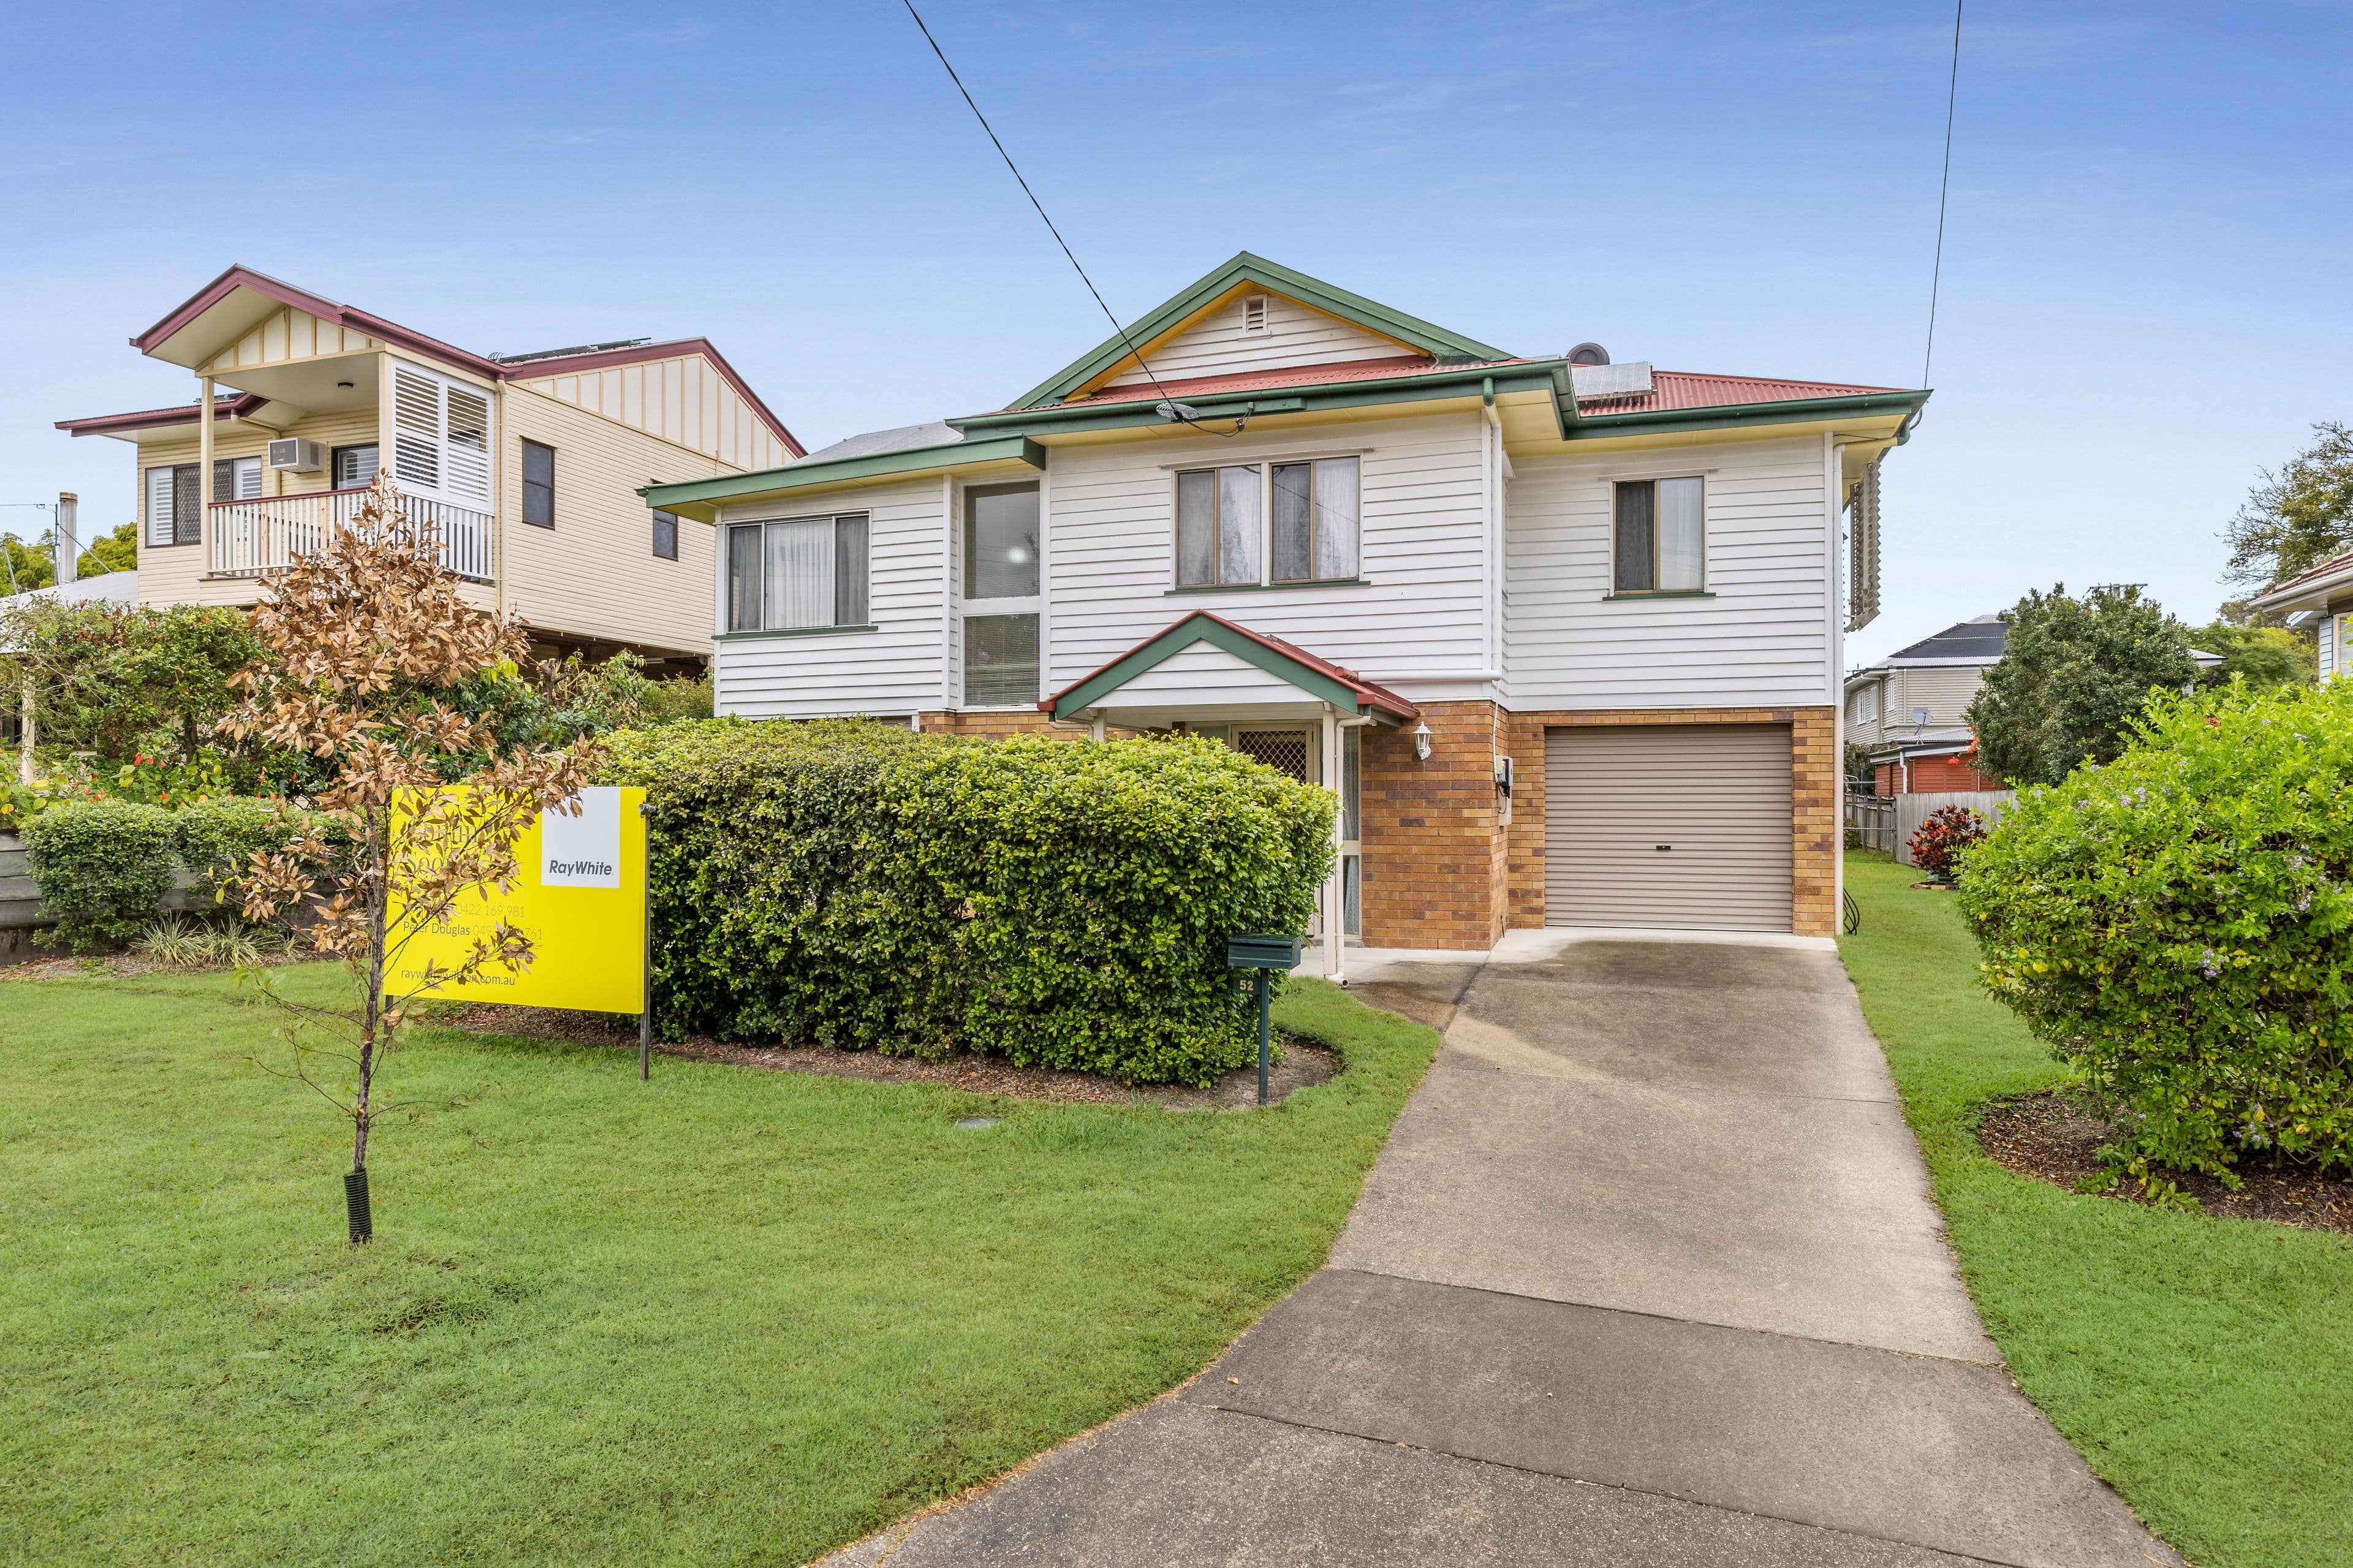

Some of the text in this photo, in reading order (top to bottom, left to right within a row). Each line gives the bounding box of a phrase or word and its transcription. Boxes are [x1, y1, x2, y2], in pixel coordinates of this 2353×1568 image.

[549, 860, 612, 877] RayWhite
[457, 903, 481, 915] 0422
[485, 904, 503, 917] 169
[507, 906, 525, 918] 981
[431, 923, 470, 937] Douglas
[525, 927, 542, 940] 761
[1240, 980, 1254, 991] 52
